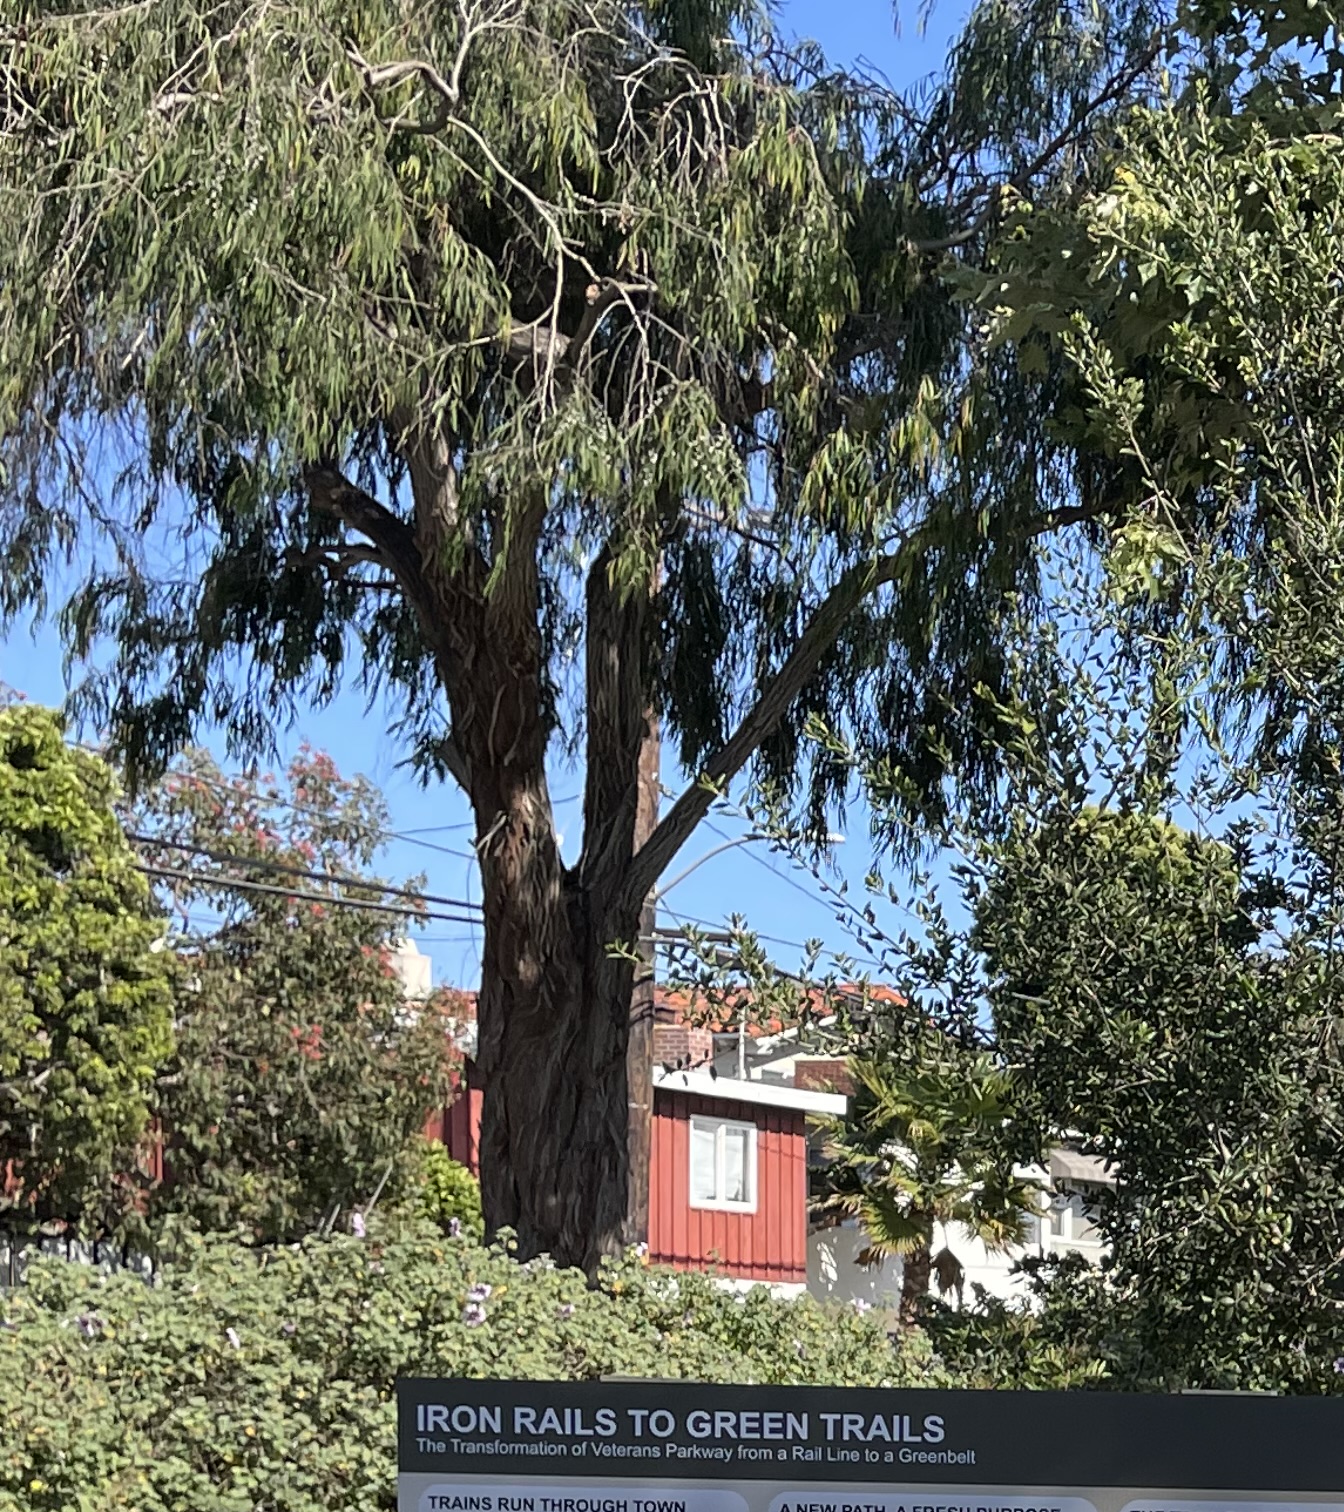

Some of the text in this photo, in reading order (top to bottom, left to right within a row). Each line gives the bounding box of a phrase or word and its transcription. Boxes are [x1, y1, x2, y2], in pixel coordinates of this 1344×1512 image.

[417, 1404, 944, 1443] IRON RAILS TO GREEN TRAILS
[415, 1438, 976, 1464] The Transformation of Veterans Parkway from a Rail Line to a Greenbelt
[428, 1494, 492, 1510] TRAINS
[498, 1495, 534, 1511] RUN
[539, 1496, 627, 1512] THROUGH
